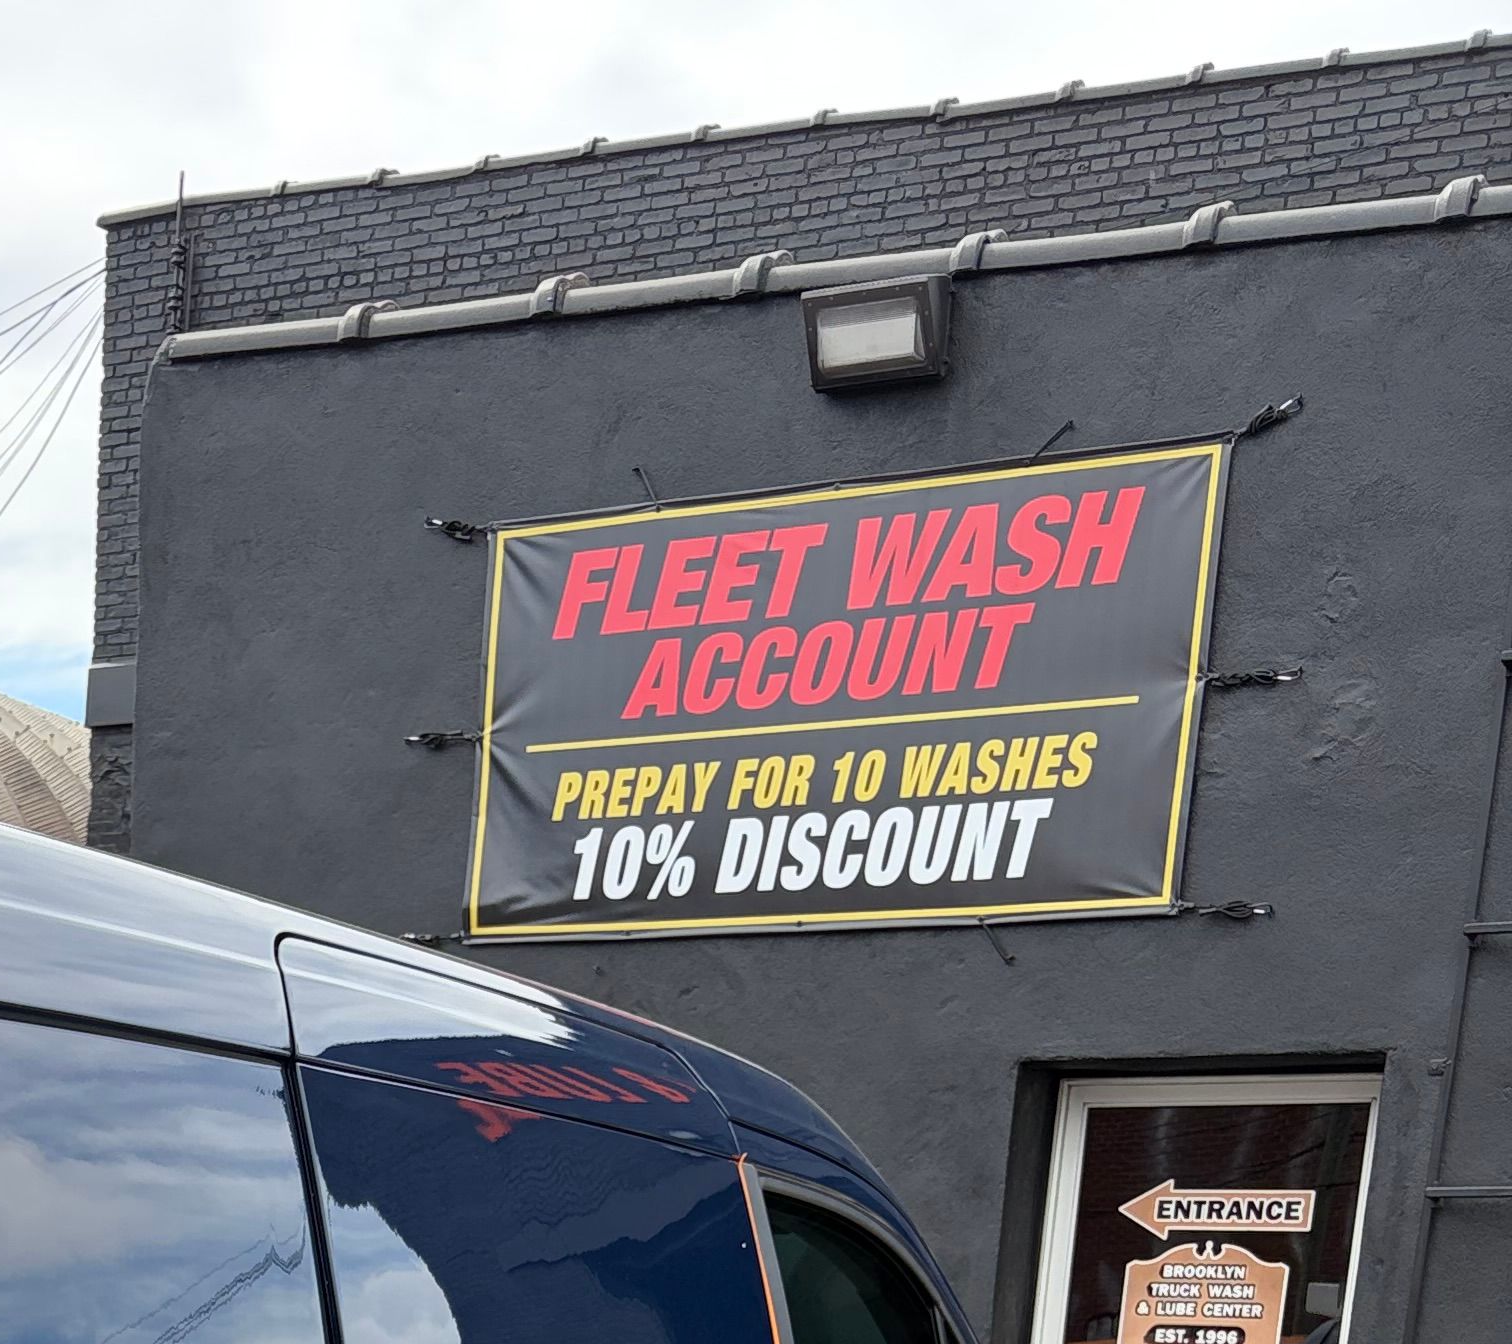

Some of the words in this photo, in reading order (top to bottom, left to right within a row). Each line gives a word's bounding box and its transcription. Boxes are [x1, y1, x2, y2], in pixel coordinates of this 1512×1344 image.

[552, 523, 829, 640] FLEET
[846, 486, 1147, 612] WASH
[621, 603, 1035, 720] ACCOUNT
[551, 761, 720, 822] PREPAY
[727, 754, 816, 811] FOR
[833, 749, 885, 805] 10
[899, 731, 1098, 799] WASHES
[571, 820, 696, 901] 10%
[715, 798, 1054, 894] DISCOUNT
[1156, 1200, 1302, 1221] ENTRANCE
[1162, 1265, 1245, 1279] BROOKLYN
[1150, 1284, 1201, 1297] TRUCK
[1208, 1284, 1254, 1298] WASH
[1137, 1302, 1149, 1315] &
[1156, 1302, 1196, 1316] LUBE
[1202, 1303, 1263, 1317] CENTER
[1154, 1329, 1188, 1344] EST.
[1195, 1330, 1238, 1344] 1996
